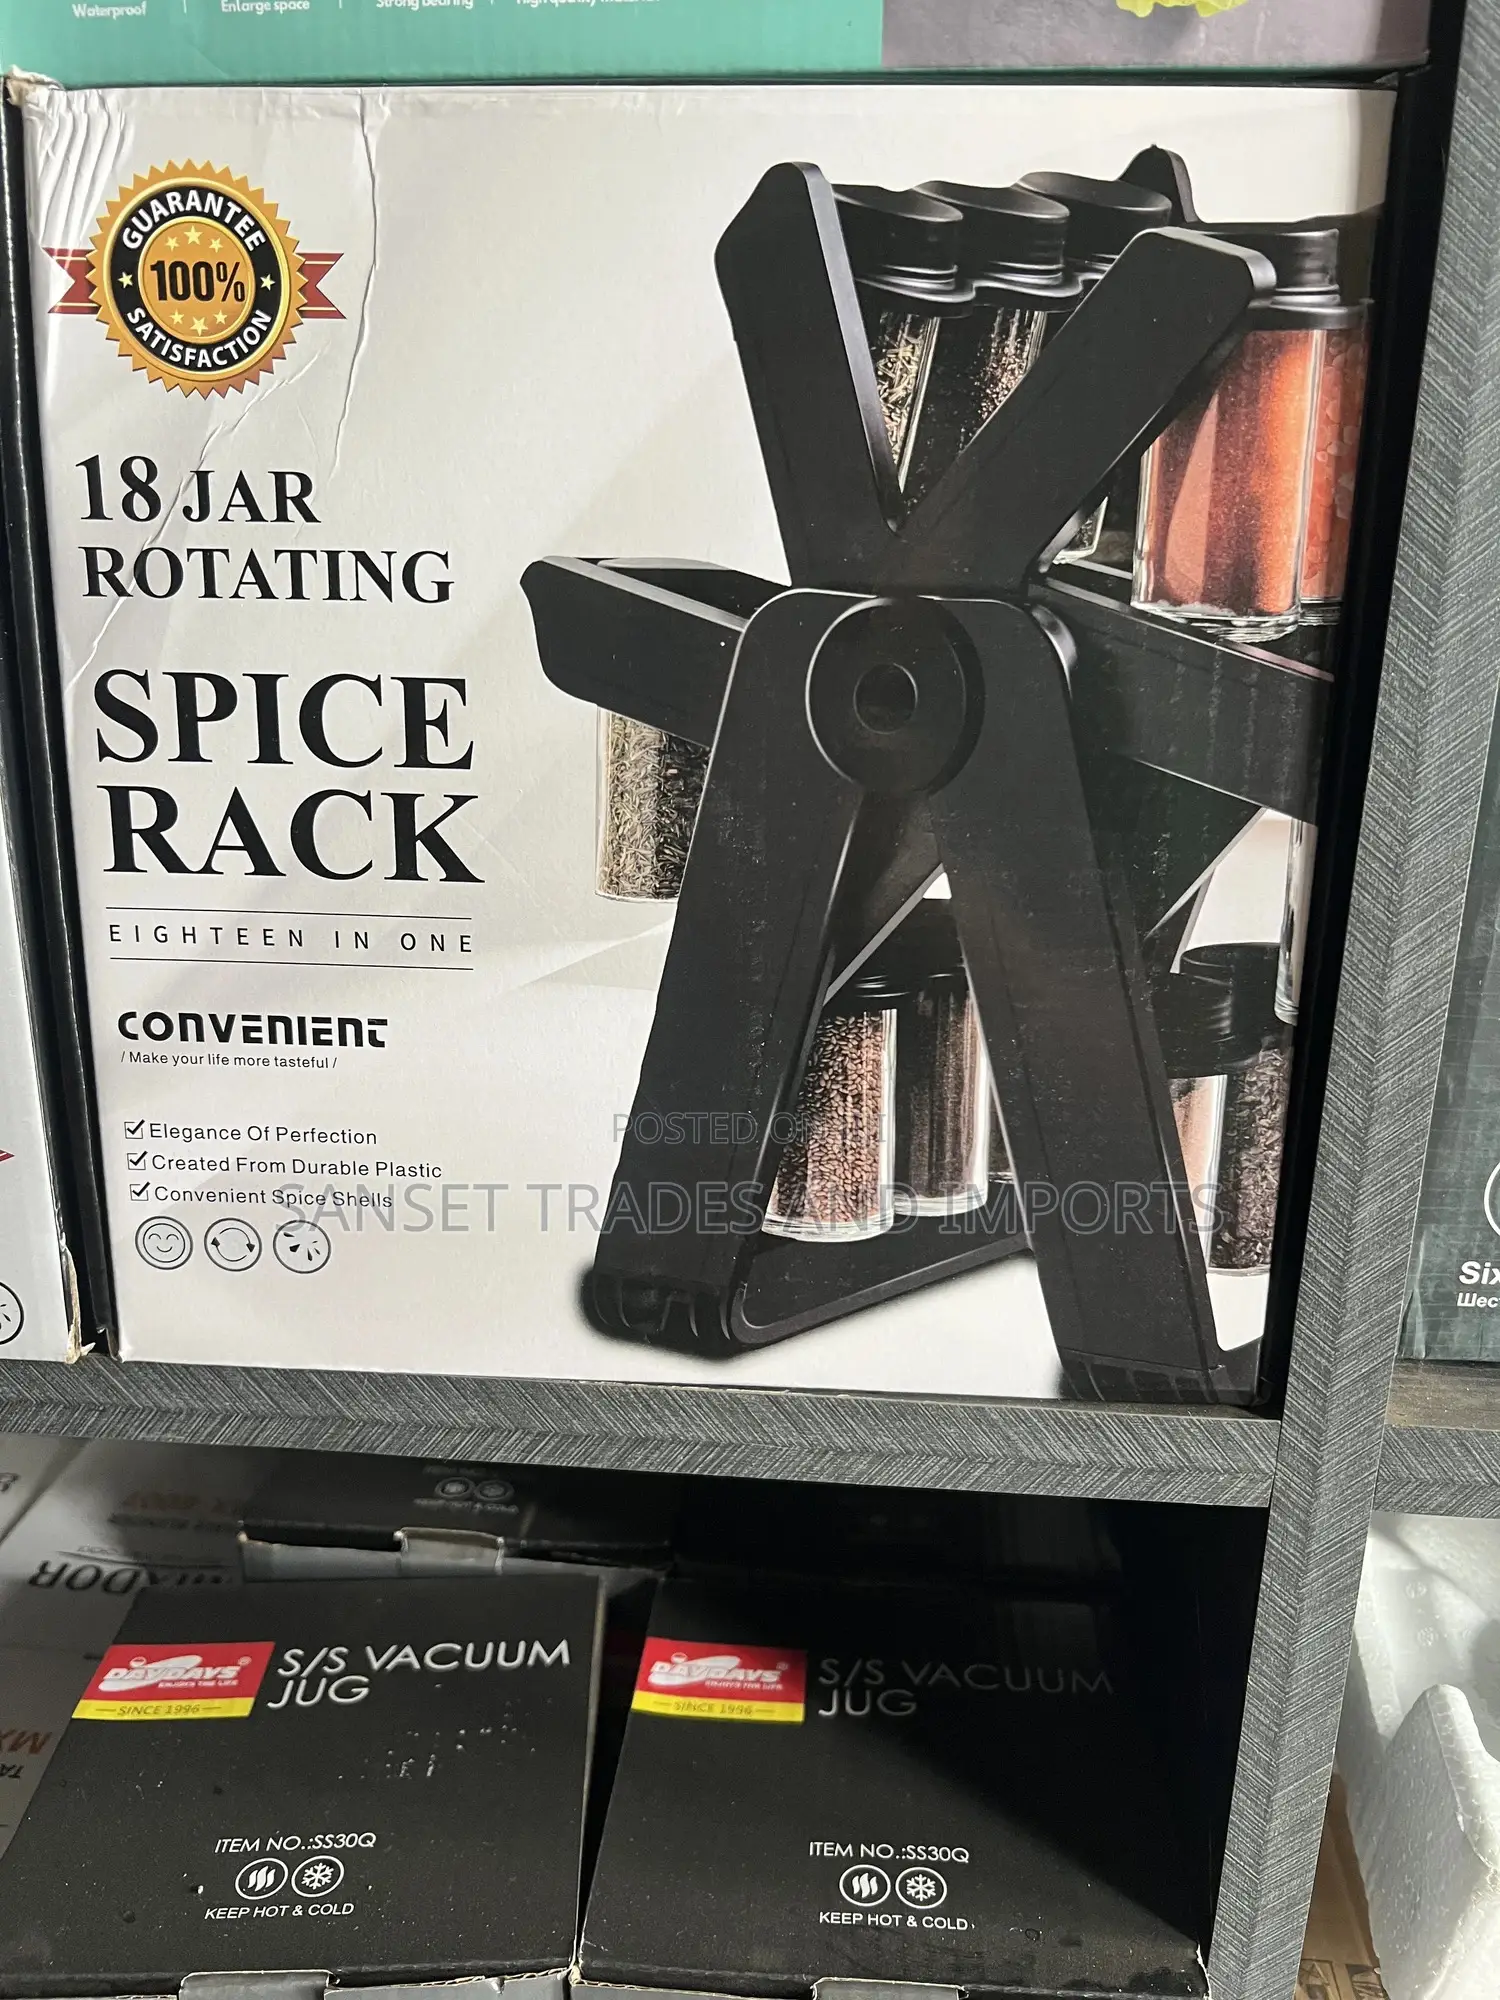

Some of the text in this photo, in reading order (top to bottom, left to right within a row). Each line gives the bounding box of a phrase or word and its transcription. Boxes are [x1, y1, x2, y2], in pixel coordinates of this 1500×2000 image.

[72, 1, 147, 19] Waterproof
[221, 0, 310, 15] Enlarge space
[122, 190, 266, 251] GUARANTEE
[150, 260, 246, 303] 100%
[126, 307, 272, 368] SATISFACTION
[76, 455, 321, 524] 18 JAR
[79, 546, 455, 603] ROTATING
[94, 669, 475, 770] SPICE
[97, 785, 485, 883] RACK
[110, 924, 472, 953] EIGHTEEN IN ONE
[118, 1011, 388, 1048] CONVENIENT
[130, 1051, 168, 1064] Make
[172, 1054, 204, 1067] your
[208, 1053, 229, 1066] life
[233, 1056, 270, 1067] more
[274, 1056, 329, 1069] tasteful
[150, 1122, 377, 1144] Elegance Of Perfection
[152, 1154, 442, 1178] Created From Durable Plastic
[154, 1185, 392, 1208] Convenient Spice Shells
[1457, 1293, 1500, 1308] Шес
[277, 1639, 570, 1678] S/S VACUUM
[818, 1658, 1114, 1695] S/S VACUUM
[267, 1675, 370, 1709] JUG
[818, 1688, 917, 1717] JUG
[117, 1704, 201, 1716] SINCE 1996
[673, 1700, 754, 1715] SINCE 1996
[214, 1832, 377, 1853] ITEM NO.:SS30Q
[809, 1841, 970, 1863] ITEM NO.:SS30Q
[204, 1903, 354, 1919] KEEP HOT & COLD
[819, 1911, 968, 1930] KEEP HOT & COLD
